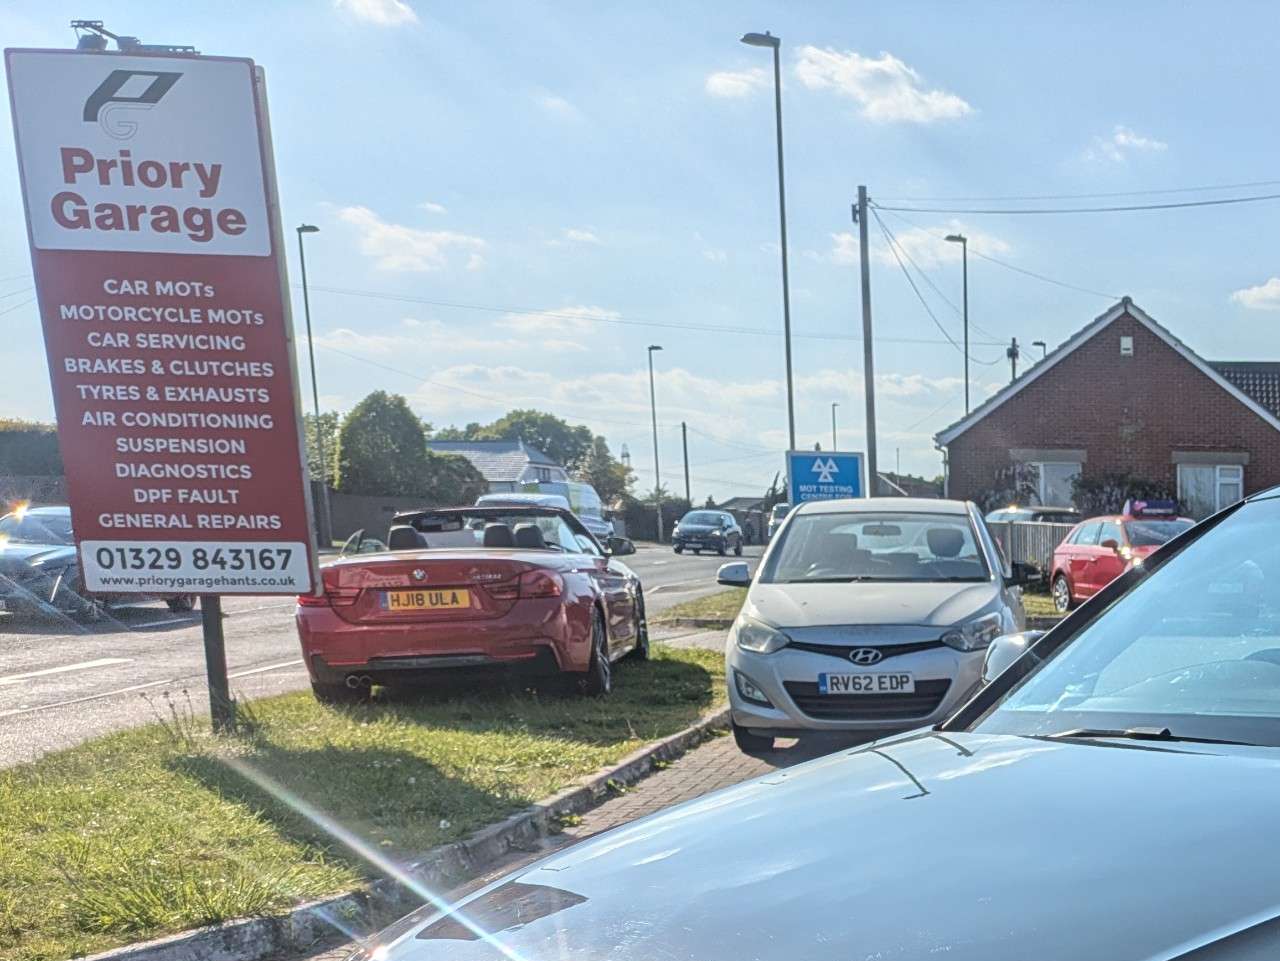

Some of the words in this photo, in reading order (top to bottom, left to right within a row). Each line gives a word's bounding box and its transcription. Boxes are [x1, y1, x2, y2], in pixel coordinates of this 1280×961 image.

[60, 147, 222, 198] Priory
[51, 191, 247, 242] Garage
[103, 279, 148, 295] CAR
[155, 281, 215, 297] MOTs
[60, 305, 202, 323] MOTORCYCLE
[207, 308, 264, 325] MOTs
[87, 332, 130, 348] CAR
[136, 333, 246, 350] SERVICING
[64, 358, 145, 374] BRAKES
[151, 360, 165, 375] &
[169, 360, 274, 378] CLUTCHES
[77, 385, 140, 400] TYRES
[146, 386, 159, 401] &
[165, 387, 270, 403] EXHAUSTS
[82, 411, 116, 427] AIR
[121, 412, 274, 429] CONDITIONING
[116, 437, 246, 454] SUSPENSION
[115, 463, 252, 480] DIAGNOSTICS
[134, 489, 172, 503] DPF
[178, 490, 239, 504] FAULT
[799, 485, 817, 493] MOT
[820, 485, 854, 493] TESTING
[99, 513, 193, 528] GENERAL
[199, 515, 281, 530] REPAIRS
[96, 547, 182, 570] 01329
[192, 548, 293, 571] 843167
[100, 575, 296, 588] www.priorygaragehants.co.uk
[391, 593, 425, 607] HJ18
[429, 592, 460, 606] ULA
[829, 675, 873, 691] RV62
[877, 674, 911, 690] EDP
